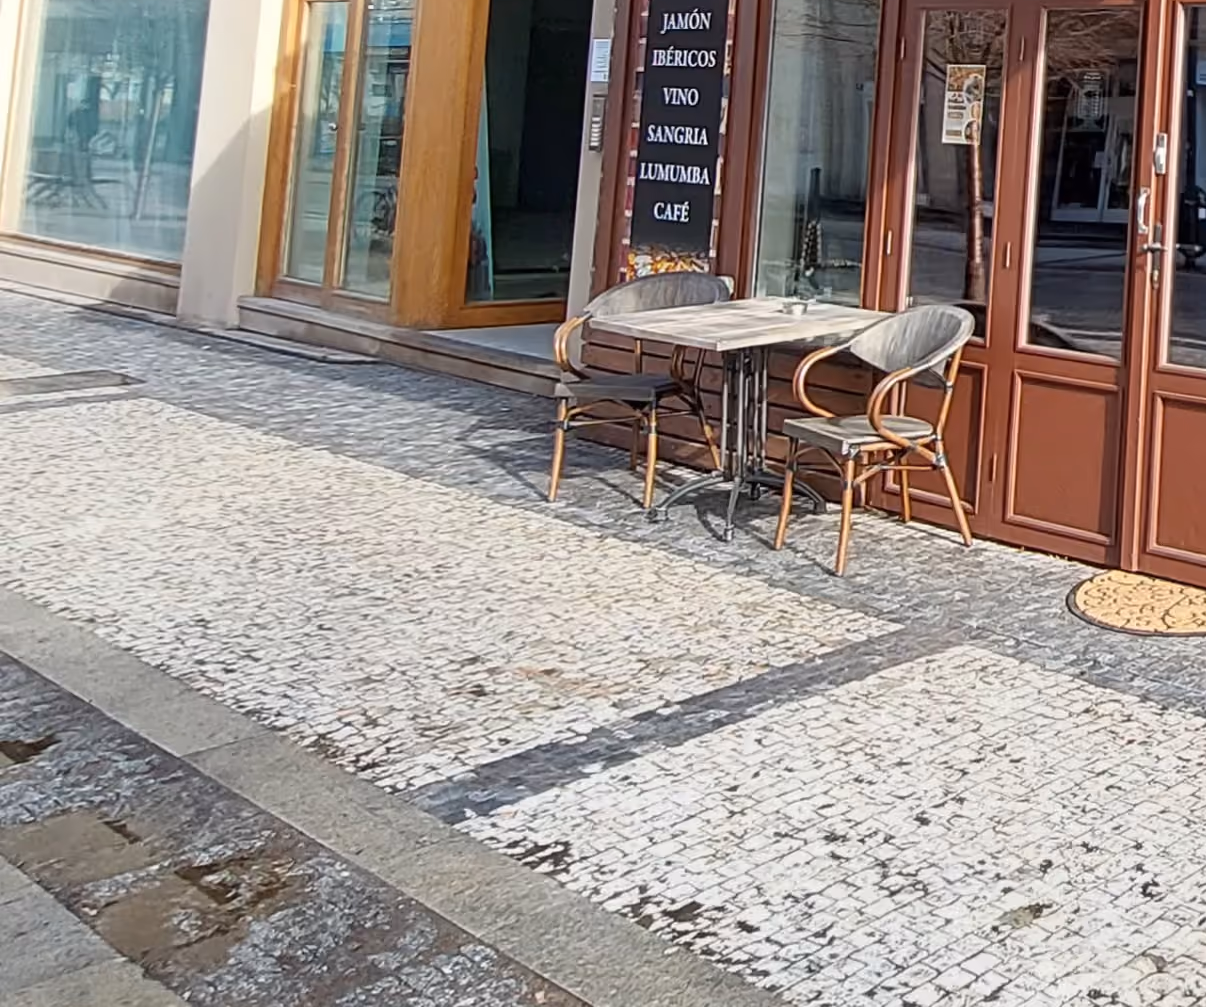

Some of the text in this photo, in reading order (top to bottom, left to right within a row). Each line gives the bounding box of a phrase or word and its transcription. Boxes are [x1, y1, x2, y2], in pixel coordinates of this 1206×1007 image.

[660, 9, 712, 34] JAMÓN
[652, 46, 717, 68] IBÉRICOS
[663, 87, 699, 106] VINO
[647, 124, 708, 145] SANGRIA
[639, 162, 710, 185] LUMUMBA
[653, 201, 690, 222] CAFÉ
